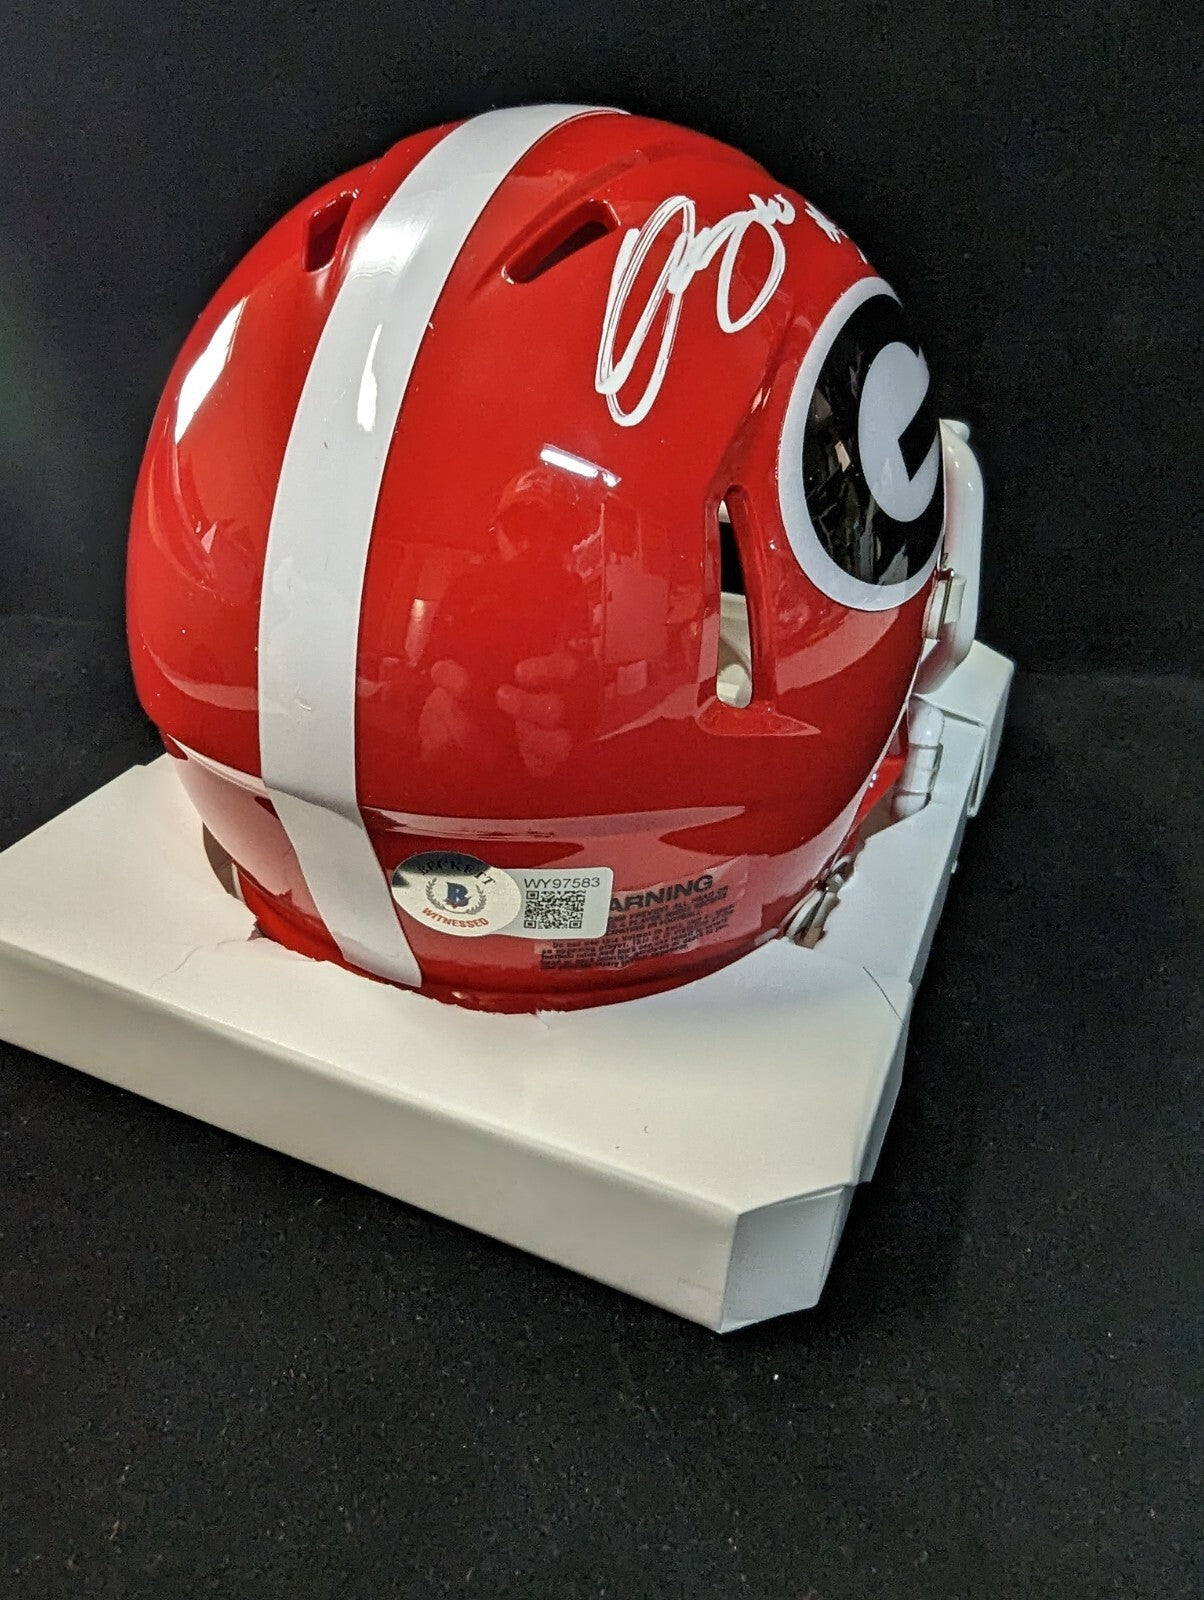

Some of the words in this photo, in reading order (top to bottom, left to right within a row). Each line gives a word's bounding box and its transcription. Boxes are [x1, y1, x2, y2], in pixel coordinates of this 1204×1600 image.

[417, 858, 497, 886] BECKETT
[524, 876, 601, 889] WY97583
[609, 874, 713, 912] ARNING
[422, 907, 490, 929] WITNESSED
